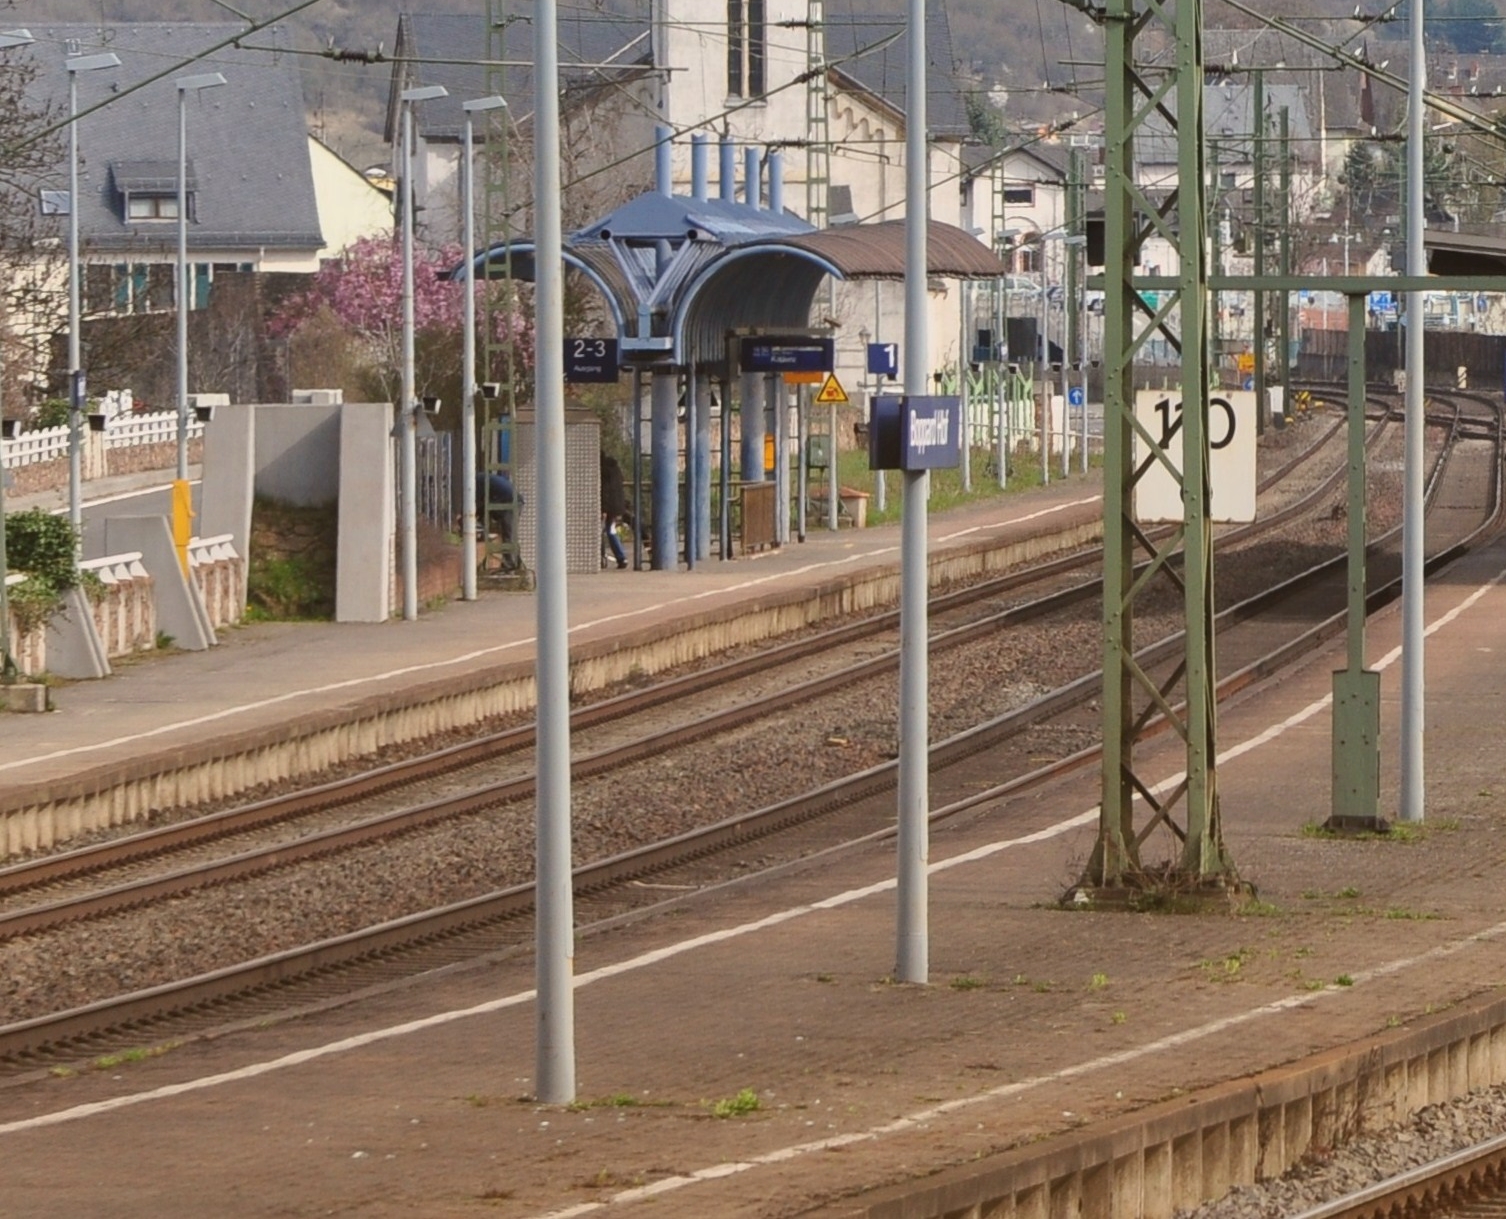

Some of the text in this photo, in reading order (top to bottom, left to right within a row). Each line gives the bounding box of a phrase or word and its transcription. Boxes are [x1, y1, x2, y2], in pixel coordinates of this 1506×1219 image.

[574, 340, 606, 357] 2-3
[884, 344, 895, 368] 1
[1154, 398, 1236, 449] 10
